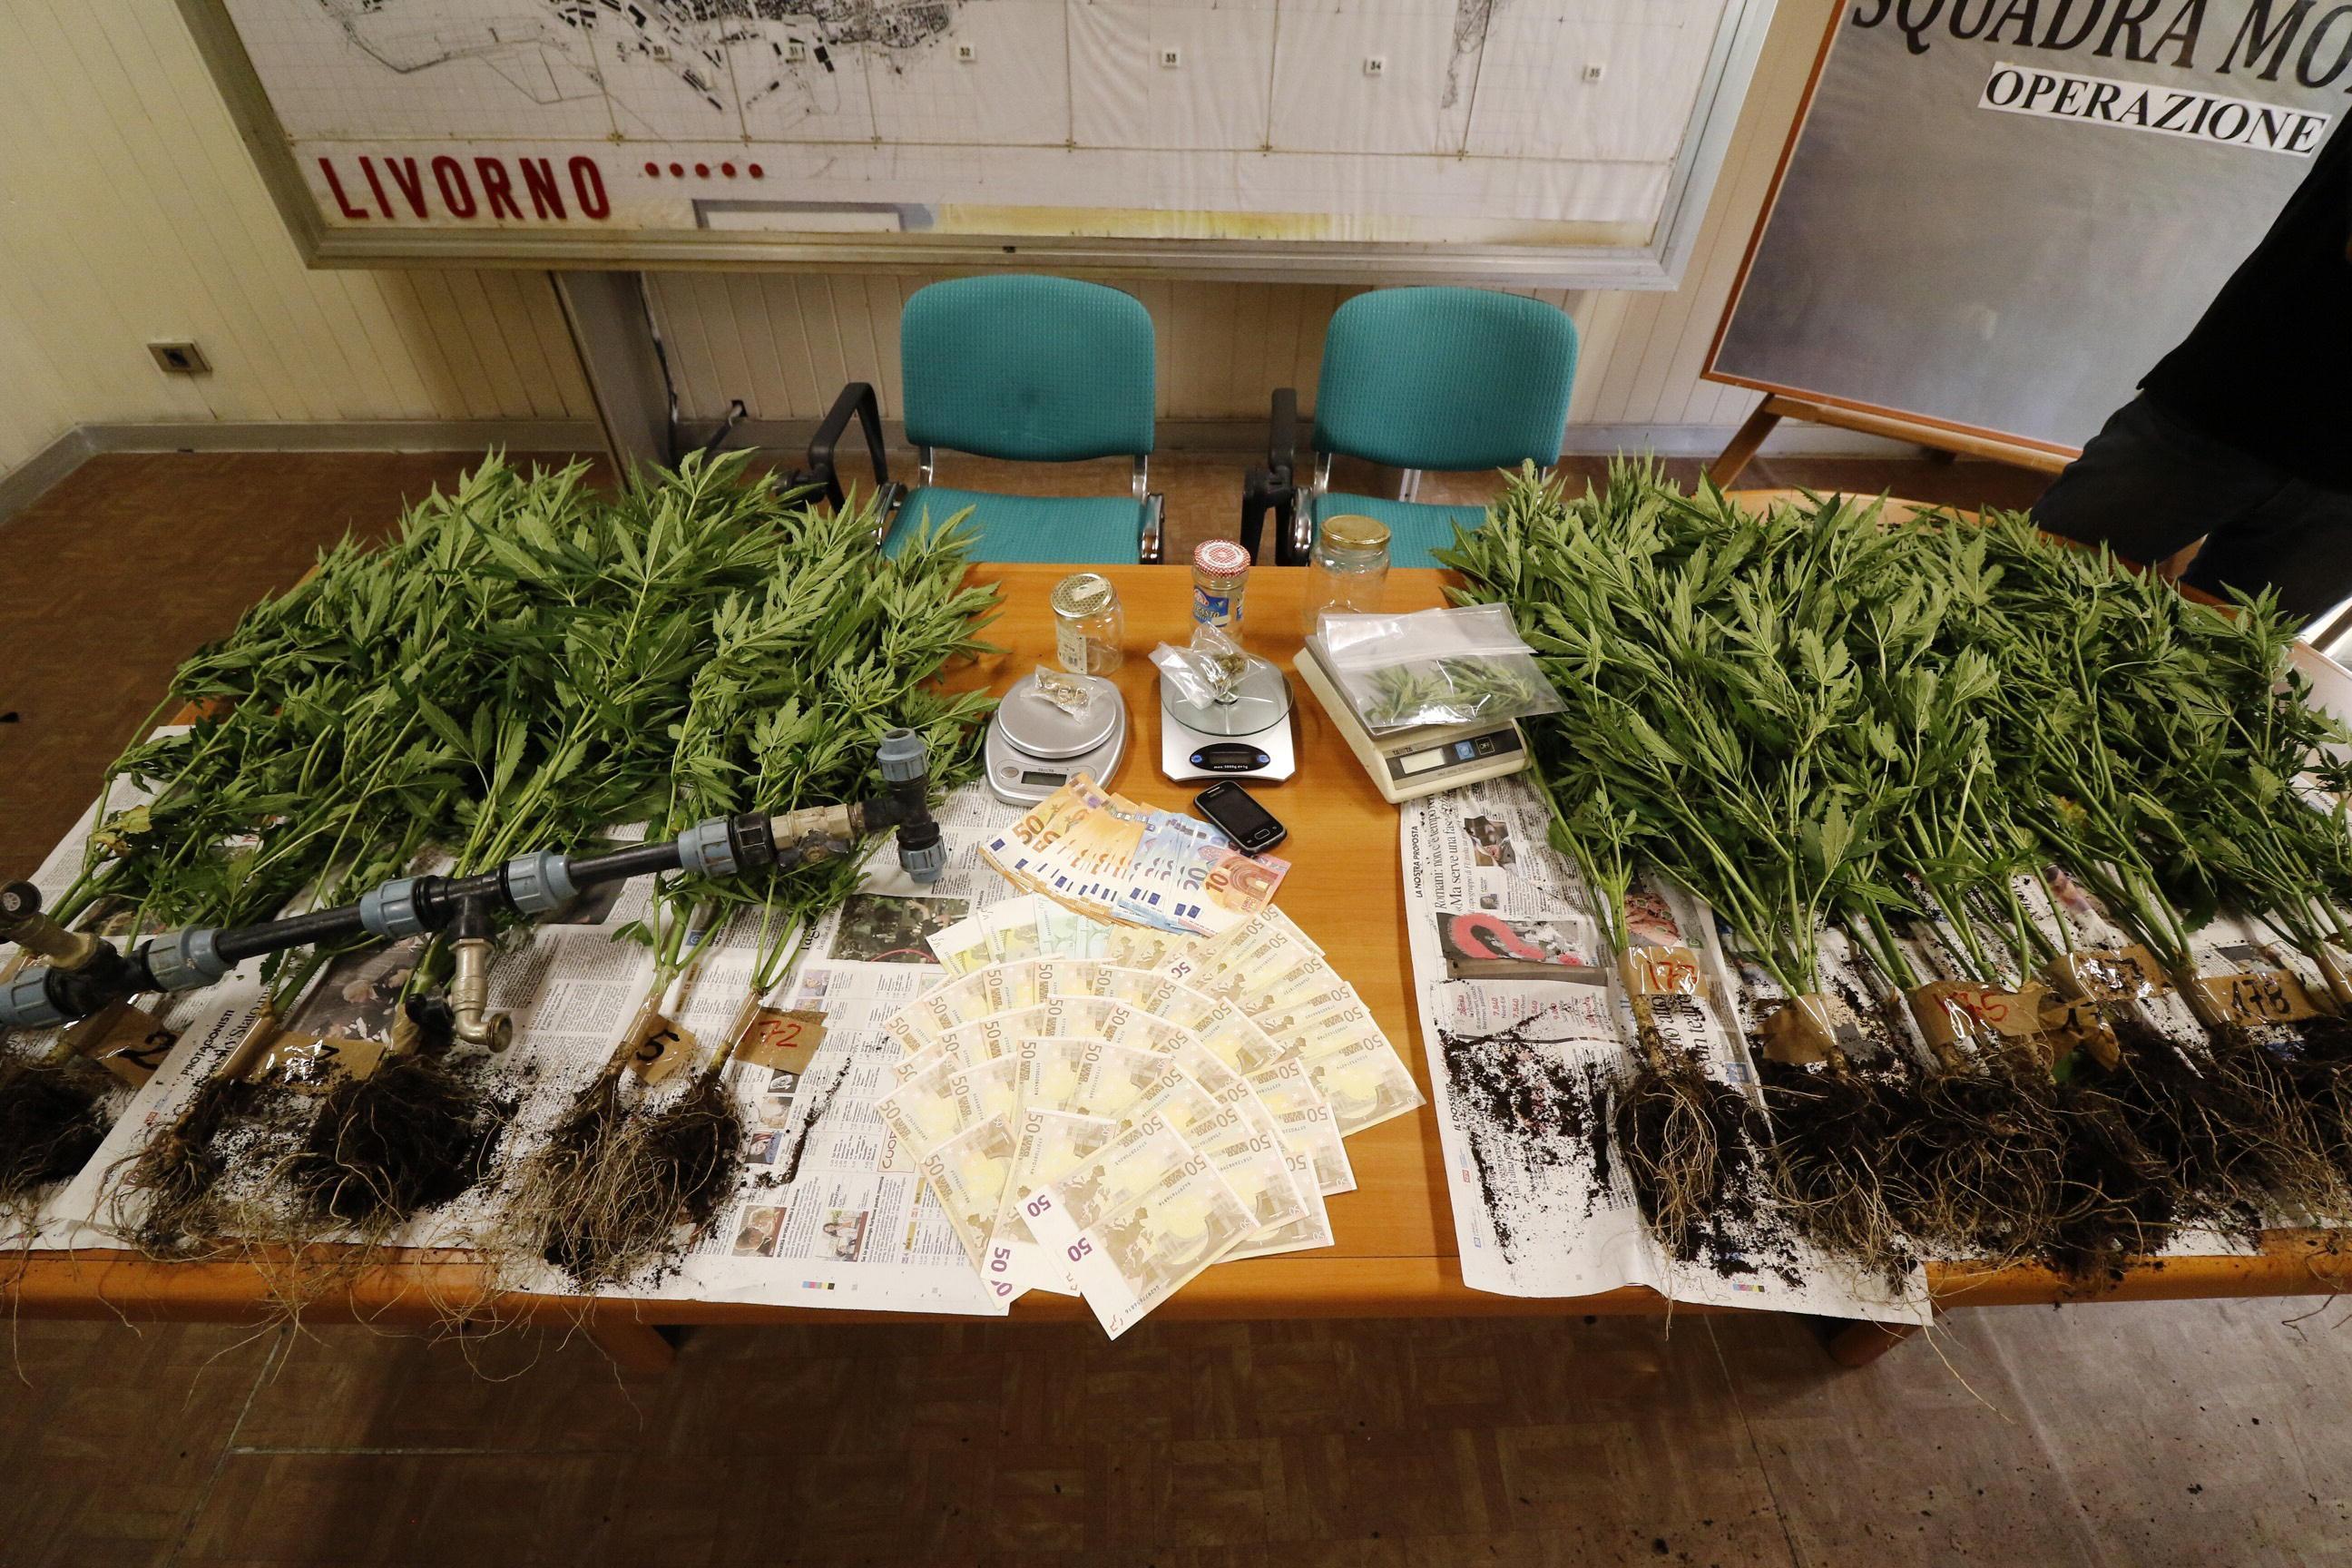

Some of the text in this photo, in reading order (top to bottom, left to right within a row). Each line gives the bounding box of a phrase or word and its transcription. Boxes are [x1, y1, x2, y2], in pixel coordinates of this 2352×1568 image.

[1851, 0, 2352, 89] SQUADRA MO
[1986, 68, 2327, 154] OPERAZIONE
[318, 155, 612, 220] LIVORNO
[1479, 742, 1490, 750] OFF
[1012, 815, 1044, 845] 50
[1427, 809, 1441, 836] tempo
[1446, 837, 1459, 854] una
[1411, 826, 1423, 898] LA NOSTRA PROPOSTA
[1449, 855, 1461, 885] serve
[1183, 867, 1209, 891] 20
[1205, 871, 1229, 893] 10
[1434, 868, 1447, 909] Romani:
[1449, 887, 1463, 911] «Ma
[1261, 907, 1279, 922] 50
[1246, 918, 1264, 936] 50
[1269, 932, 1289, 949] 50
[1039, 964, 1053, 981] 50
[1303, 957, 1323, 975] 50
[987, 970, 1003, 987] 50
[1097, 969, 1112, 986] 50
[1158, 982, 1177, 1000] 50
[1330, 986, 1351, 1002] 50
[929, 995, 947, 1014] 50
[1048, 999, 1063, 1015] 50
[1211, 1002, 1233, 1021] 50
[1491, 997, 1499, 1016] 7.840
[1511, 998, 1519, 1019] 7.540
[1112, 1007, 1130, 1026] 50
[1343, 1006, 1365, 1023] 50
[1680, 995, 1706, 1034] teatro
[889, 1016, 909, 1035] 50
[985, 1021, 1002, 1039] 50
[181, 1010, 236, 1076] PROTAGONISTI
[942, 1033, 960, 1052] 50
[1168, 1031, 1189, 1051] 50
[1364, 1034, 1384, 1051] 50
[1022, 1042, 1037, 1060] 50
[1085, 1044, 1102, 1062] 50
[1161, 1069, 1183, 1088] 50
[1279, 1063, 1300, 1079] 50
[953, 1076, 970, 1096] 50
[1227, 1083, 1249, 1102] 50
[879, 1099, 901, 1120] 50
[1446, 1083, 1459, 1122] DOSSIER
[1025, 1113, 1044, 1133] 50
[1216, 1108, 1239, 1128] 50
[1308, 1106, 1329, 1122] 50
[1142, 1116, 1164, 1136] 50
[1250, 1134, 1272, 1153] 50
[925, 1154, 945, 1176] 50
[1184, 1154, 1207, 1176] 50
[1027, 1194, 1052, 1218] 50
[1067, 1237, 1093, 1262] 50
[991, 1247, 1011, 1272] 50
